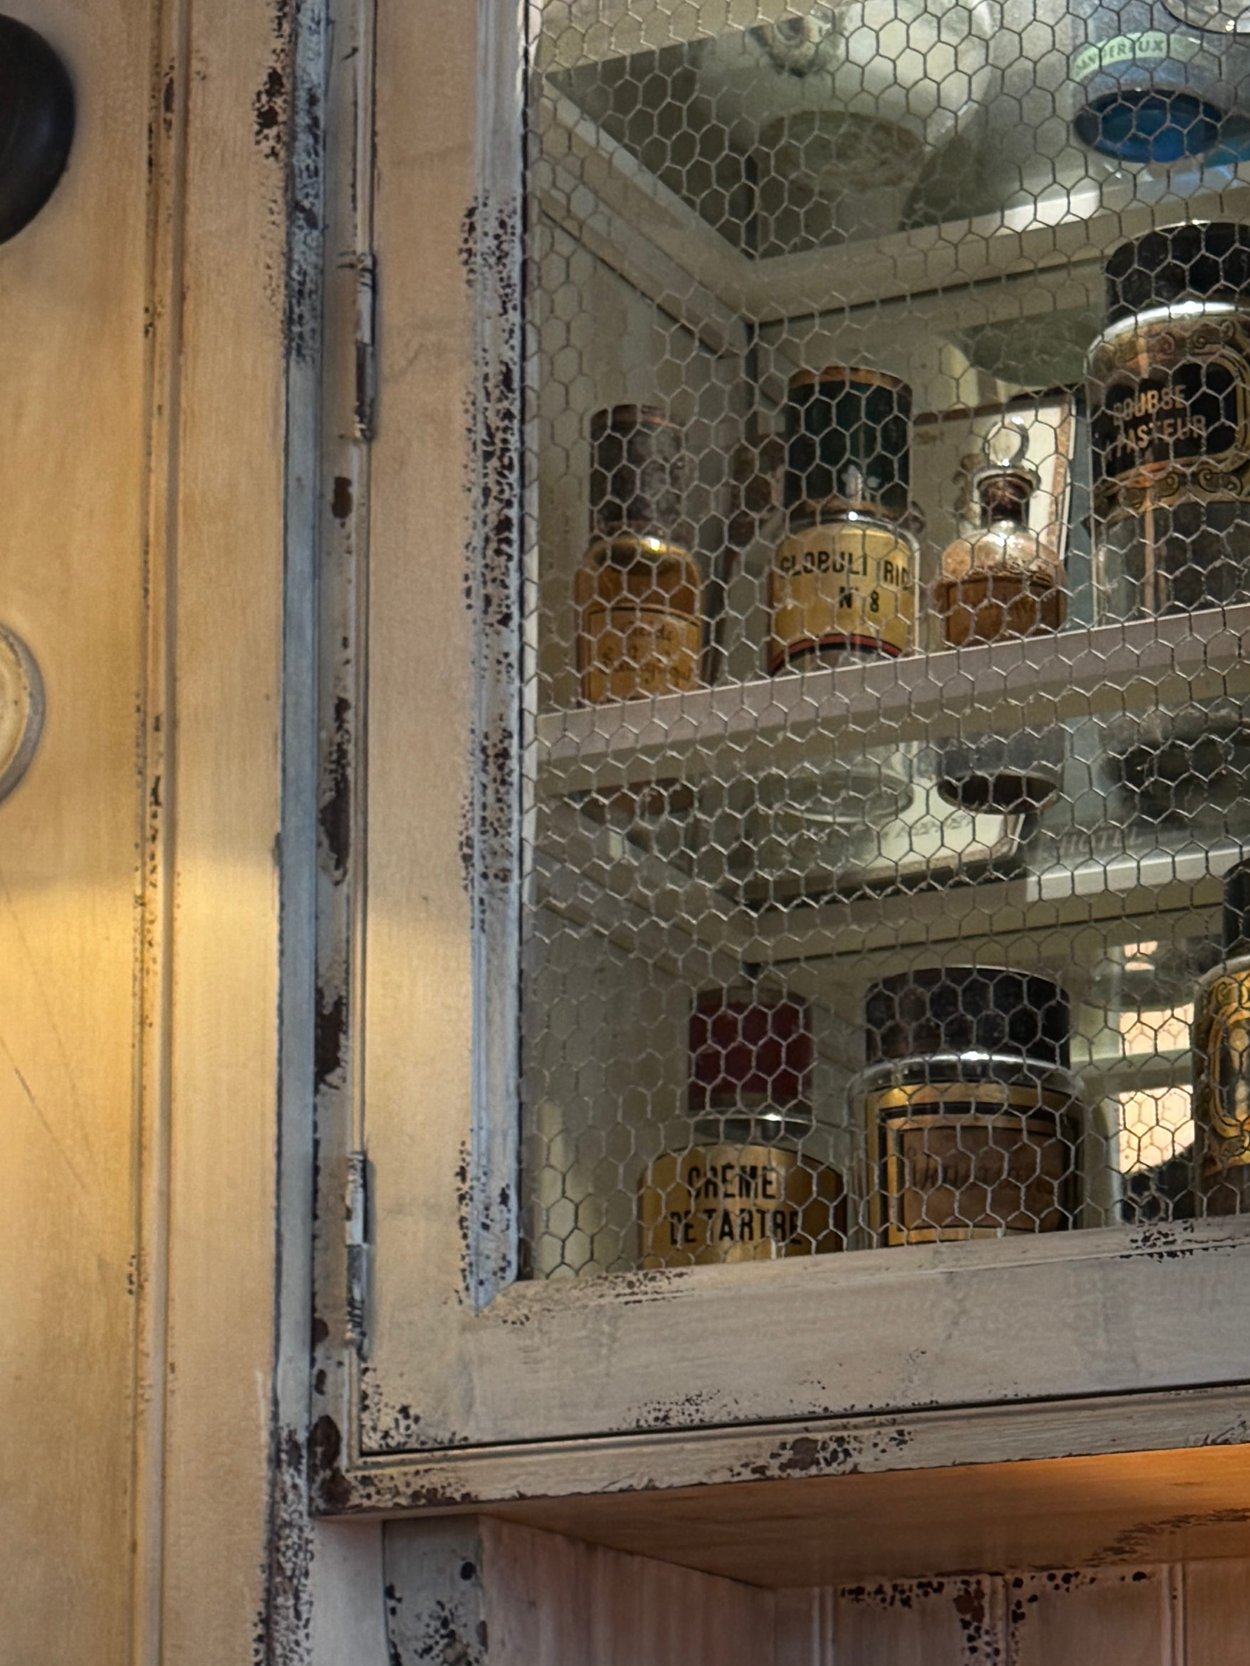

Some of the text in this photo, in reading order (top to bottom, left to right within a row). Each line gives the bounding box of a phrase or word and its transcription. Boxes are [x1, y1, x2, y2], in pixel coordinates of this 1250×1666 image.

[780, 550, 867, 577] GLOBULI
[869, 589, 880, 613] 8
[669, 1208, 802, 1246] DE TARTRE
